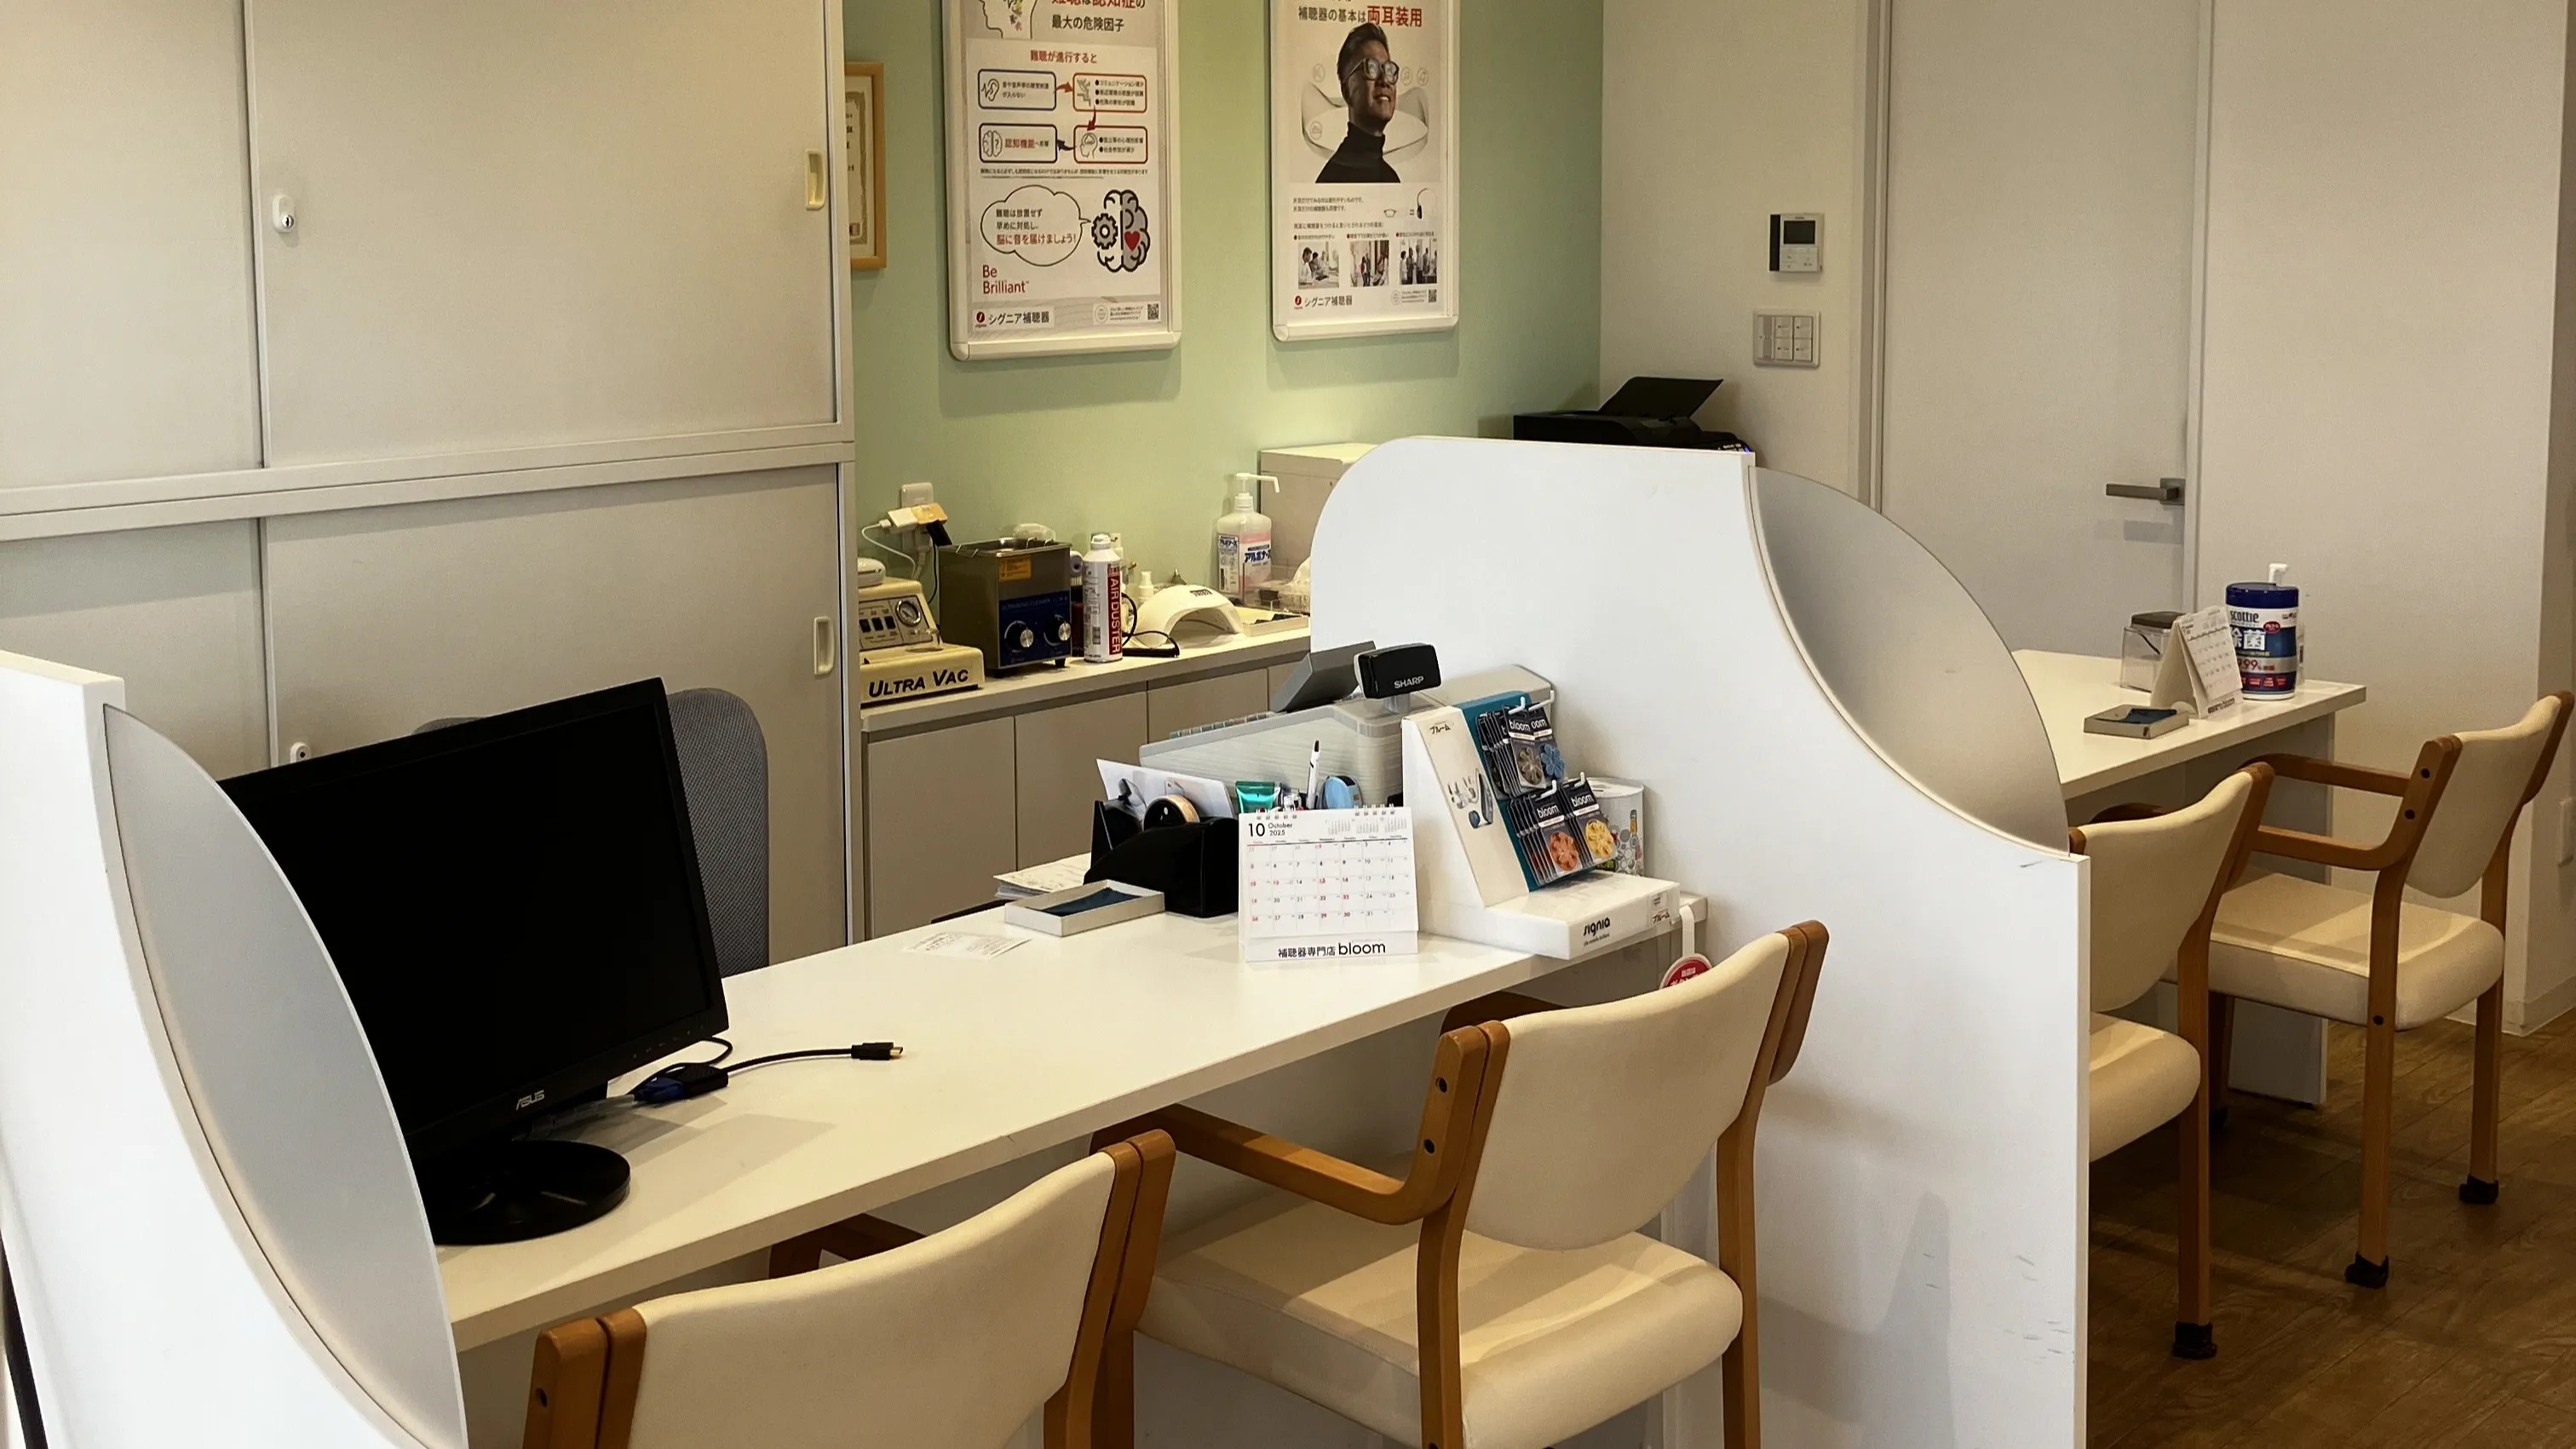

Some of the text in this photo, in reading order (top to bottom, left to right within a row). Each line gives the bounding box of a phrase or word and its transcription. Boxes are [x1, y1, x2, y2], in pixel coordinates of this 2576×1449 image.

[1052, 14, 1124, 32] 最大の危険因子
[982, 264, 998, 278] Be
[1110, 578, 1120, 600] AIR
[1110, 601, 1121, 653] DUSTER
[868, 669, 969, 698] ULTRA VAC
[1394, 676, 1424, 689] SHARP
[1509, 719, 1531, 732] bloom
[1531, 718, 1548, 730] oom
[1571, 794, 1595, 807] bloom
[1537, 804, 1561, 819] bloom
[1248, 821, 1293, 837] 10 October
[1583, 917, 1611, 937] signia
[1278, 941, 1386, 958] 補聴器専門店 bloom
[515, 1090, 545, 1110] ASUS
